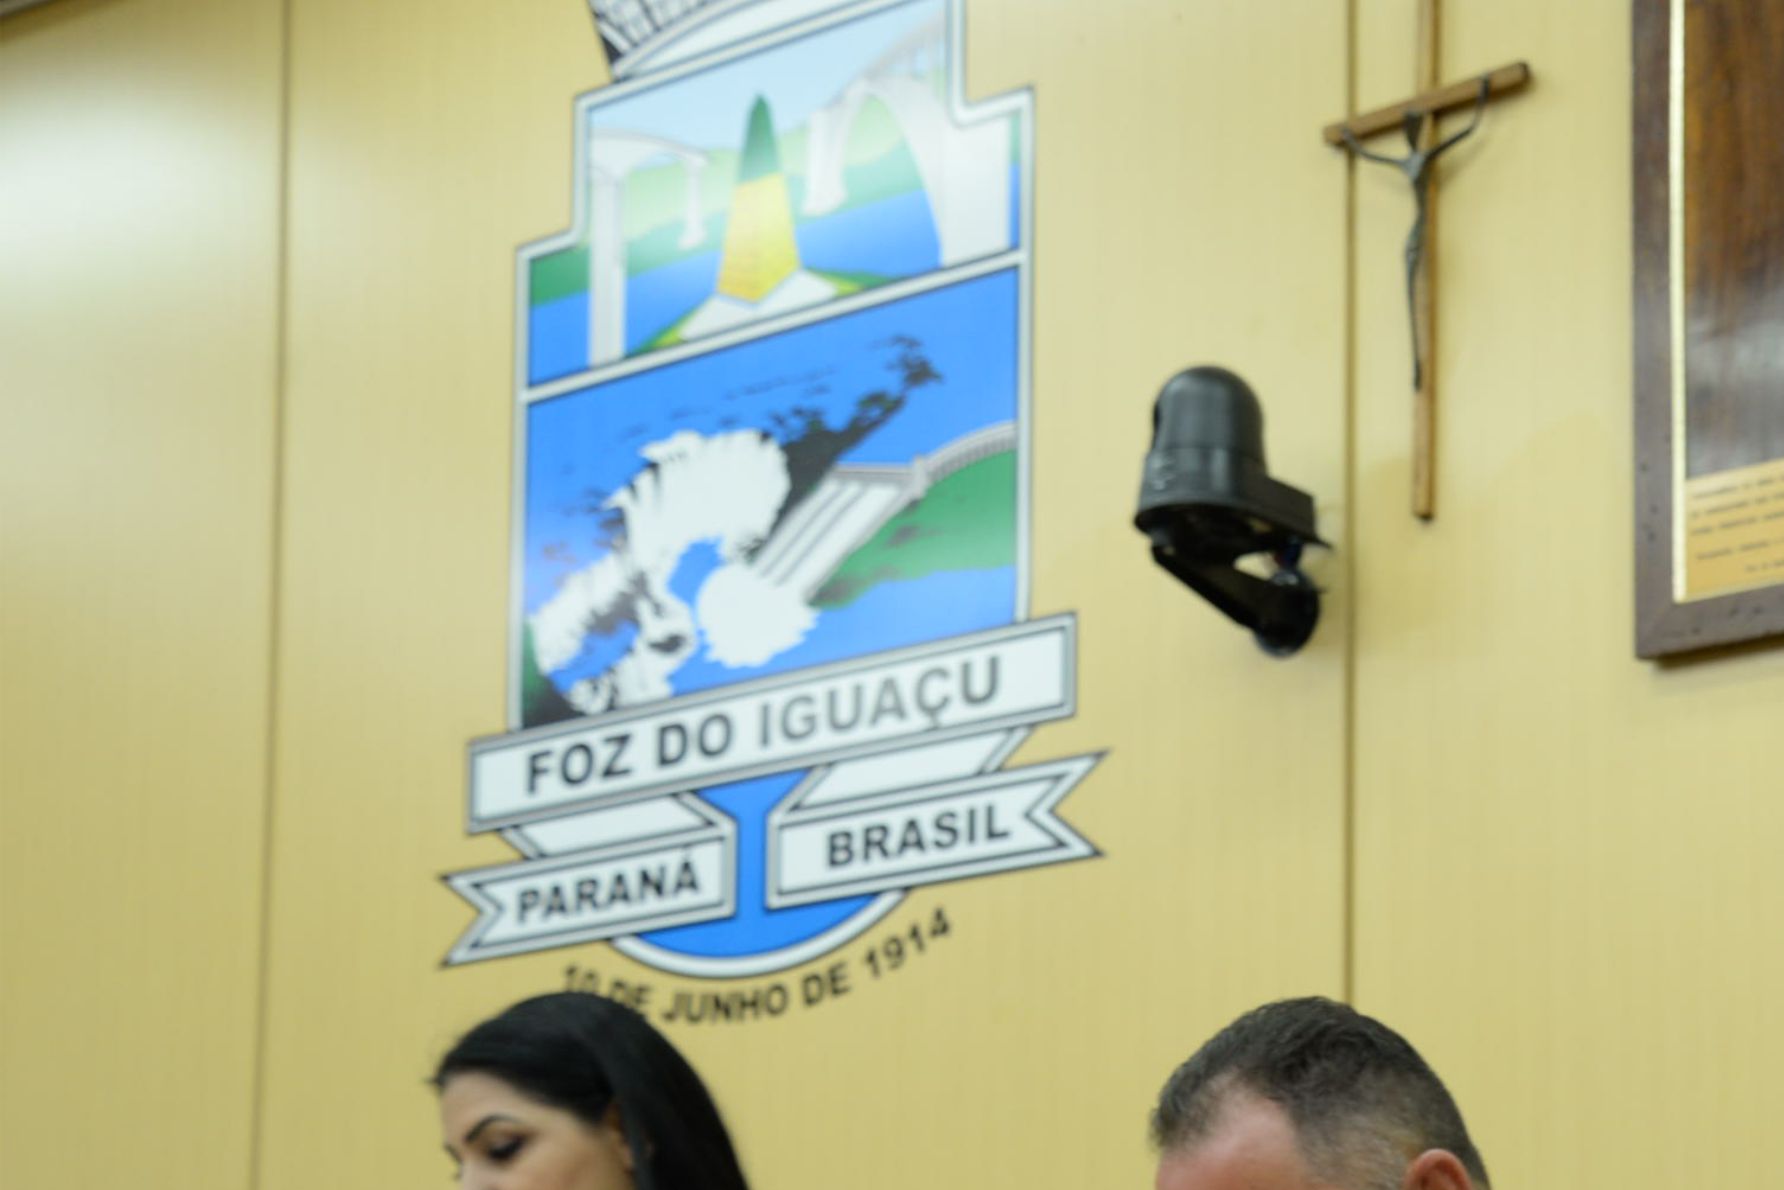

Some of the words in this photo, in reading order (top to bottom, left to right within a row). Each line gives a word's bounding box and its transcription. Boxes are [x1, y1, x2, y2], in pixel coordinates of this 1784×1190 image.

[527, 734, 634, 795] FOZ
[657, 711, 732, 768] DO
[759, 655, 1000, 748] IGUAÇU
[517, 845, 701, 924] PARANÁ
[827, 804, 1012, 868] BRASIL
[661, 984, 790, 1025] JUNHO
[803, 964, 852, 1009] DE
[863, 907, 953, 978] 1914
